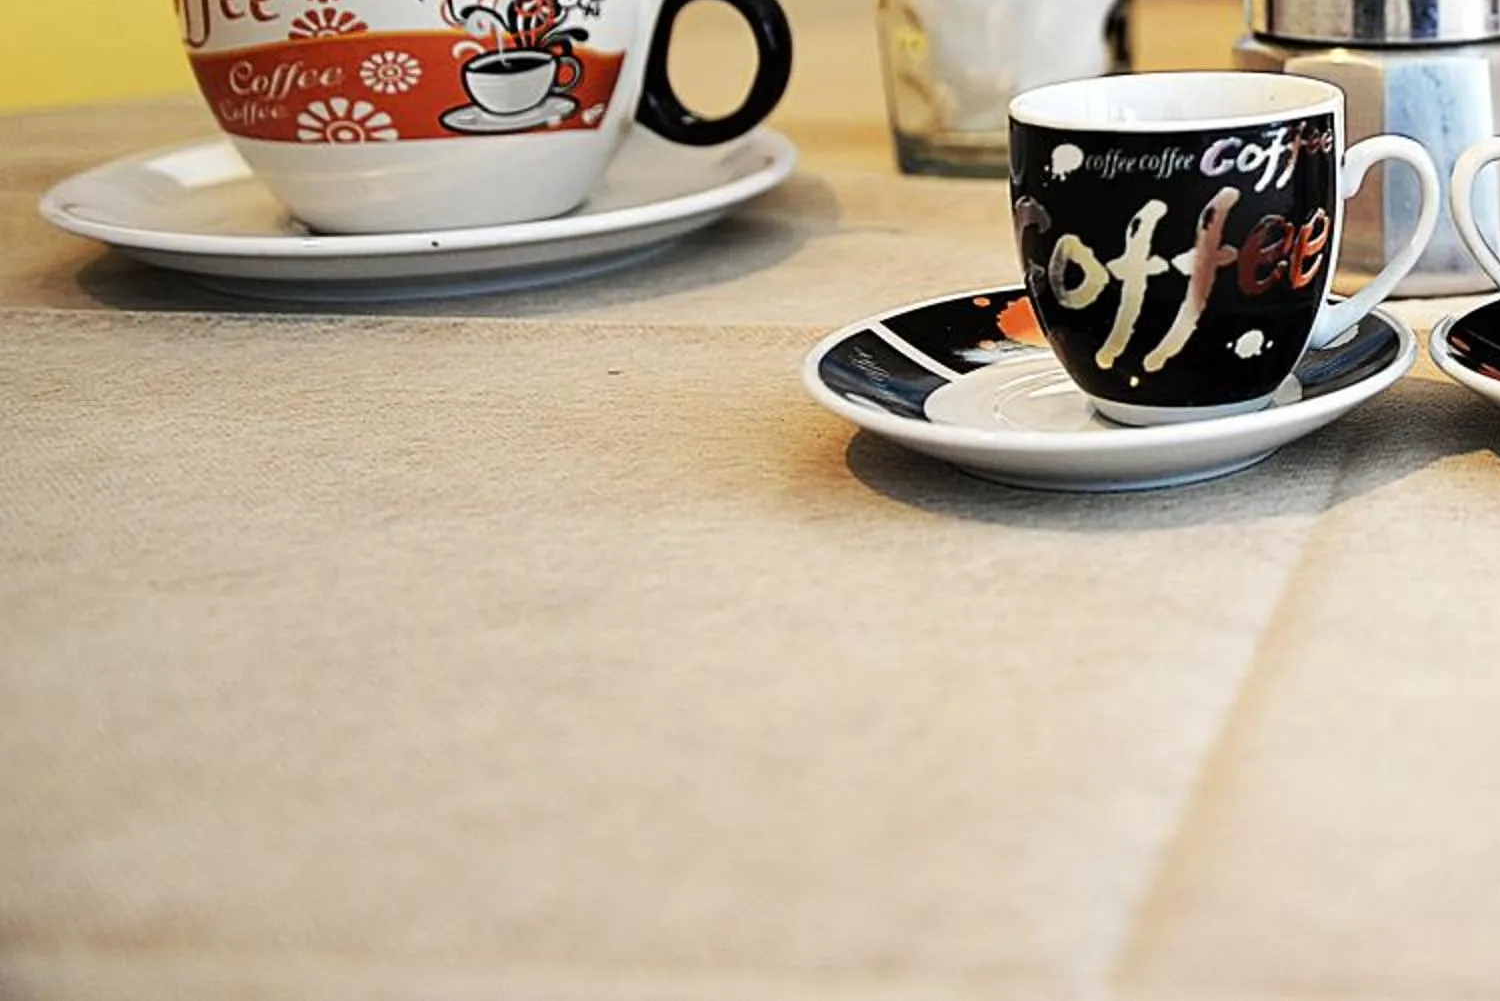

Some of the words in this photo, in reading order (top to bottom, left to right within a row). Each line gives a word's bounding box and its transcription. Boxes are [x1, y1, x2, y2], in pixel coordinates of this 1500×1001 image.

[229, 61, 343, 100] Coffee
[1085, 148, 1135, 179] coffee
[1138, 147, 1195, 179] coffee
